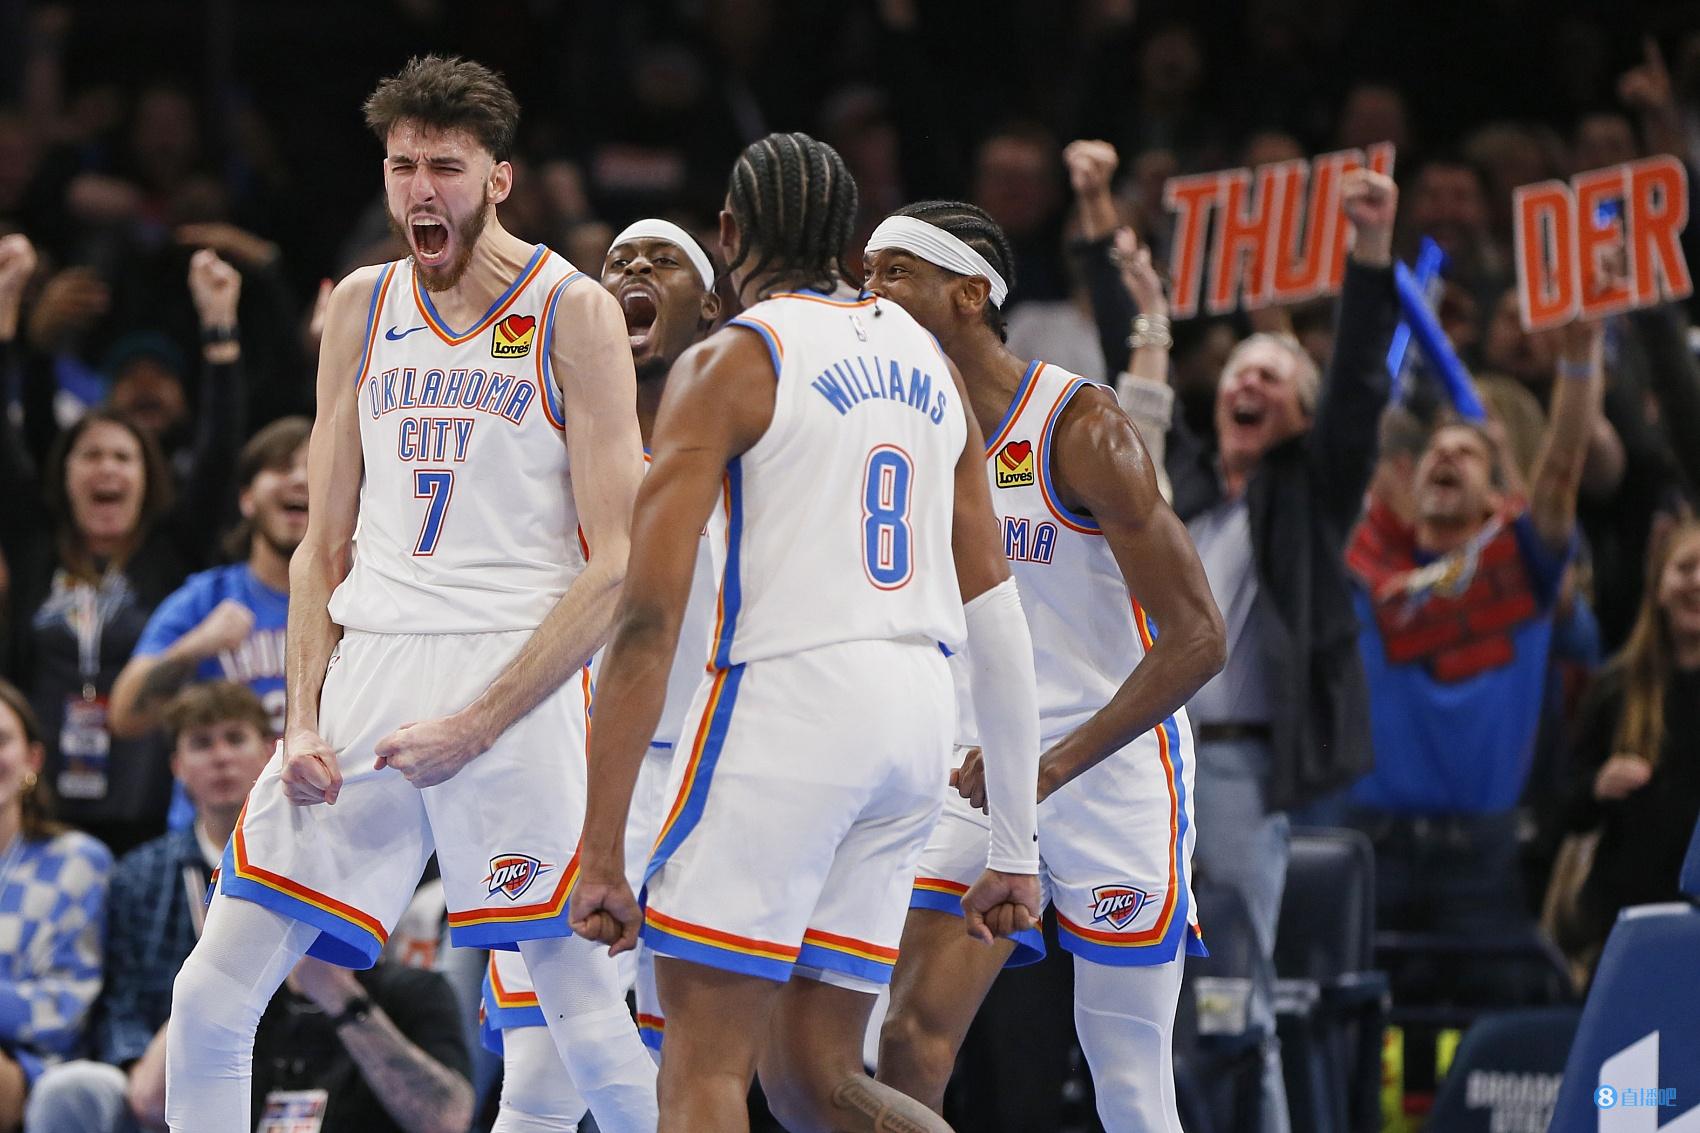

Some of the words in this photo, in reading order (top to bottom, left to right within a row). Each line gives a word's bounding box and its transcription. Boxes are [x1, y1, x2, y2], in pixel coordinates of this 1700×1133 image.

[1513, 154, 1693, 333] DER
[494, 341, 530, 354] Love's
[368, 367, 537, 426] OKLAHOMA
[811, 355, 947, 426] WILLIAMS
[398, 417, 475, 463] CITY
[412, 469, 455, 557] 7
[861, 443, 915, 592] 8
[995, 516, 1058, 565] MA
[489, 862, 528, 892] OKC
[1094, 893, 1134, 919] OKC
